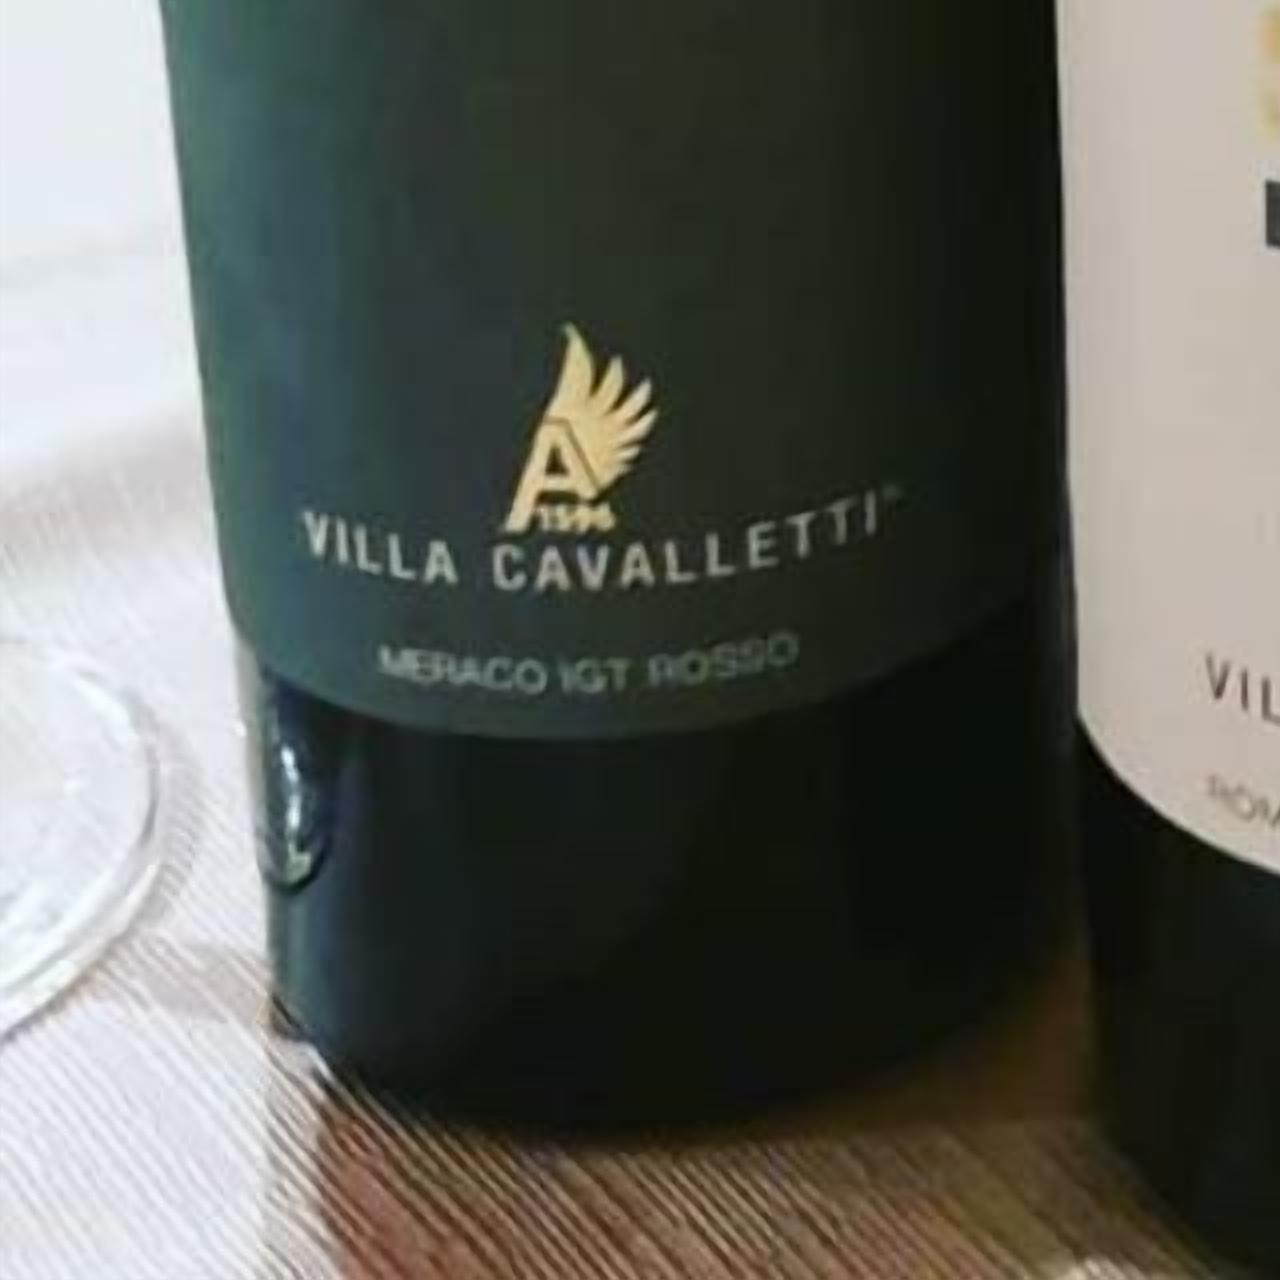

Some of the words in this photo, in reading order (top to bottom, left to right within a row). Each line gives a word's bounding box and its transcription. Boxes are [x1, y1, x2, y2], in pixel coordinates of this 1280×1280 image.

[301, 508, 460, 587] VILLA
[491, 488, 878, 593] CAVALLETTI
[378, 644, 549, 696] MERACO
[562, 655, 630, 696] IGT
[649, 631, 800, 689] ROSSO
